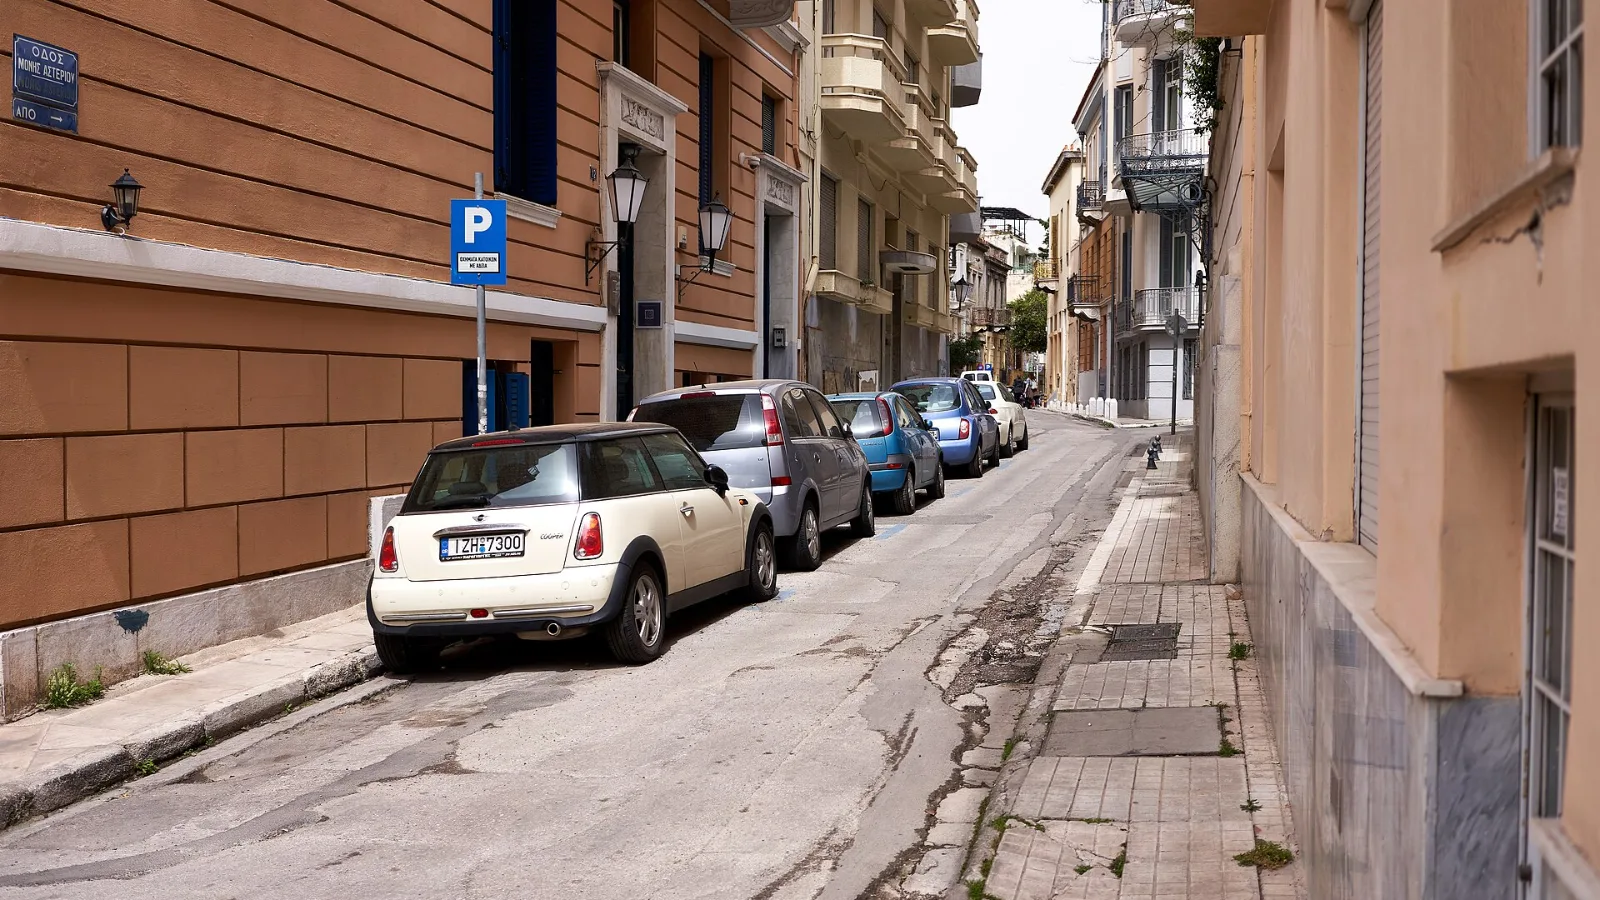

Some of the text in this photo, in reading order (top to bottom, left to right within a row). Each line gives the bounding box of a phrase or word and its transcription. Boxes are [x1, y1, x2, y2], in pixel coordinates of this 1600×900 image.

[32, 46, 64, 65] ΟΔΟΣ
[18, 57, 75, 84] ΜΟΝΗΣ ΑΣΤΕΡΙΟΥ
[16, 105, 36, 120] ΑΠΟ
[464, 206, 493, 244] P
